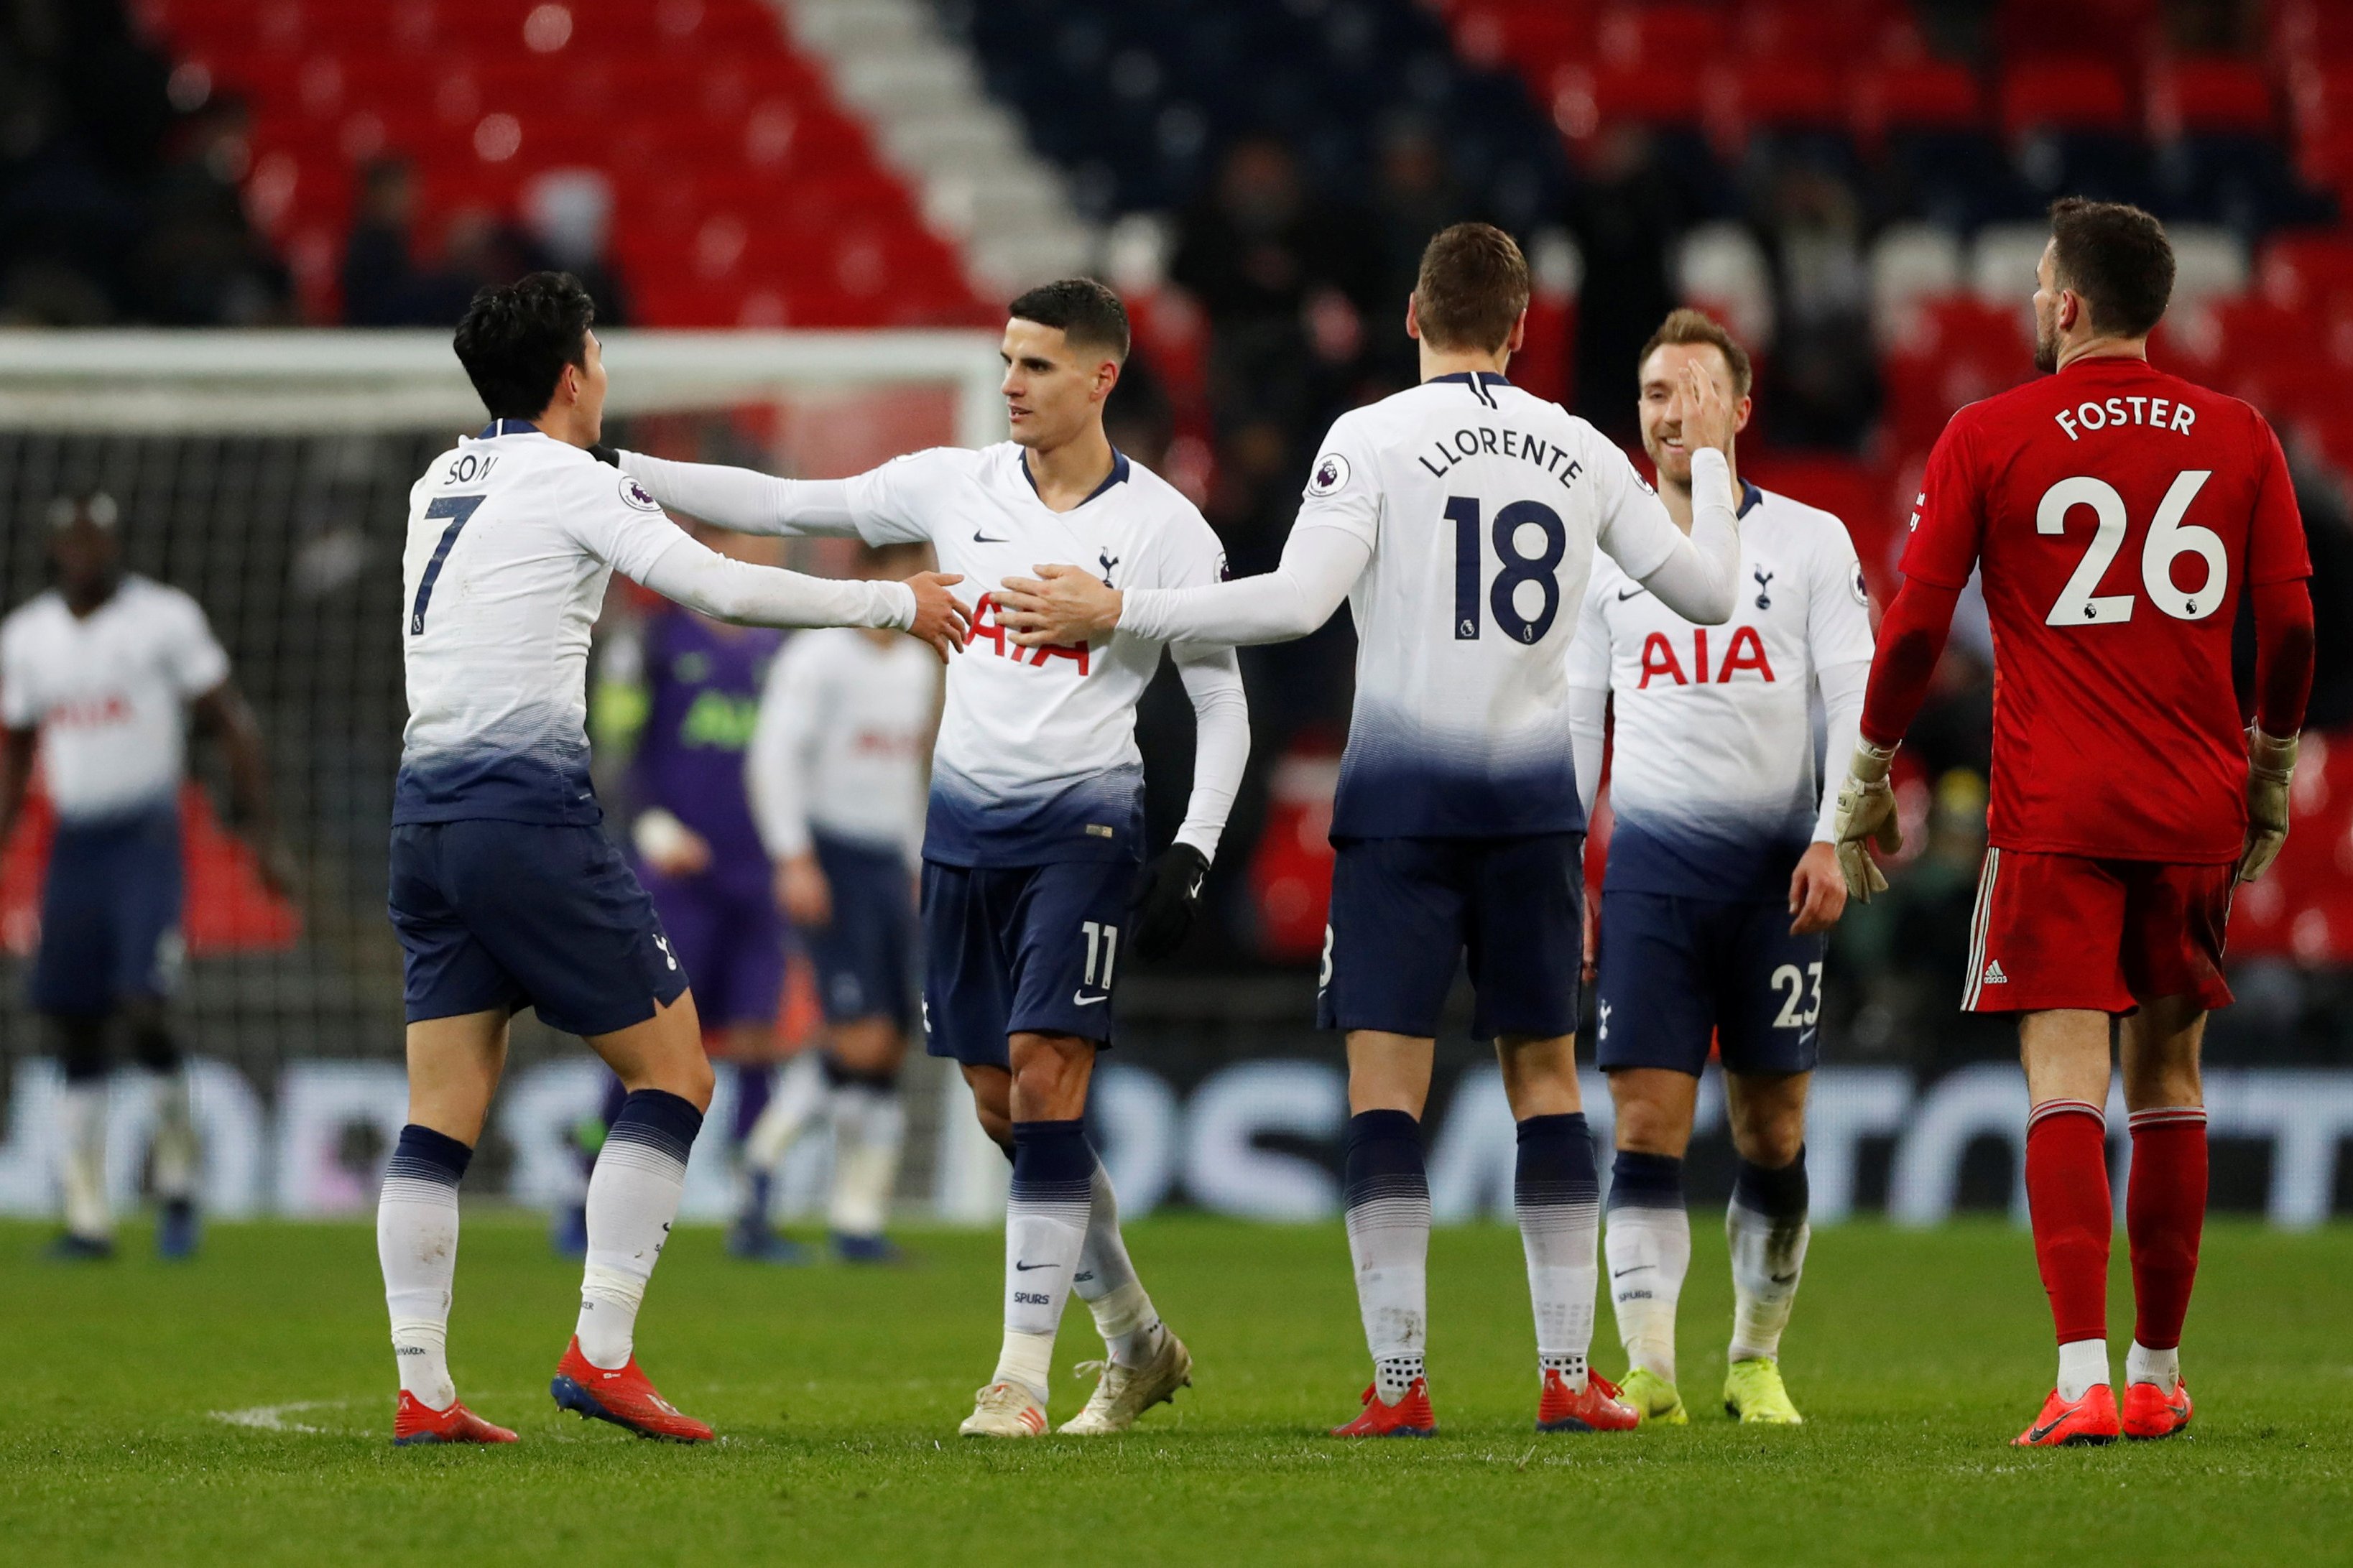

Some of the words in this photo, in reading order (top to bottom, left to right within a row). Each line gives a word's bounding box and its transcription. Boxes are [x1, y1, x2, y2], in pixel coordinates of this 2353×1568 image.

[2054, 396, 2196, 441] FOSTER
[443, 454, 499, 486] SON
[1418, 427, 1583, 488] LLORENTE
[410, 494, 487, 635] 7
[1443, 496, 1566, 645] 18
[2036, 470, 2227, 626] 26
[1637, 625, 1775, 690] AIA
[1082, 921, 1117, 989] 11
[1771, 961, 1823, 1029] 23
[1014, 1291, 1050, 1304] SPURS
